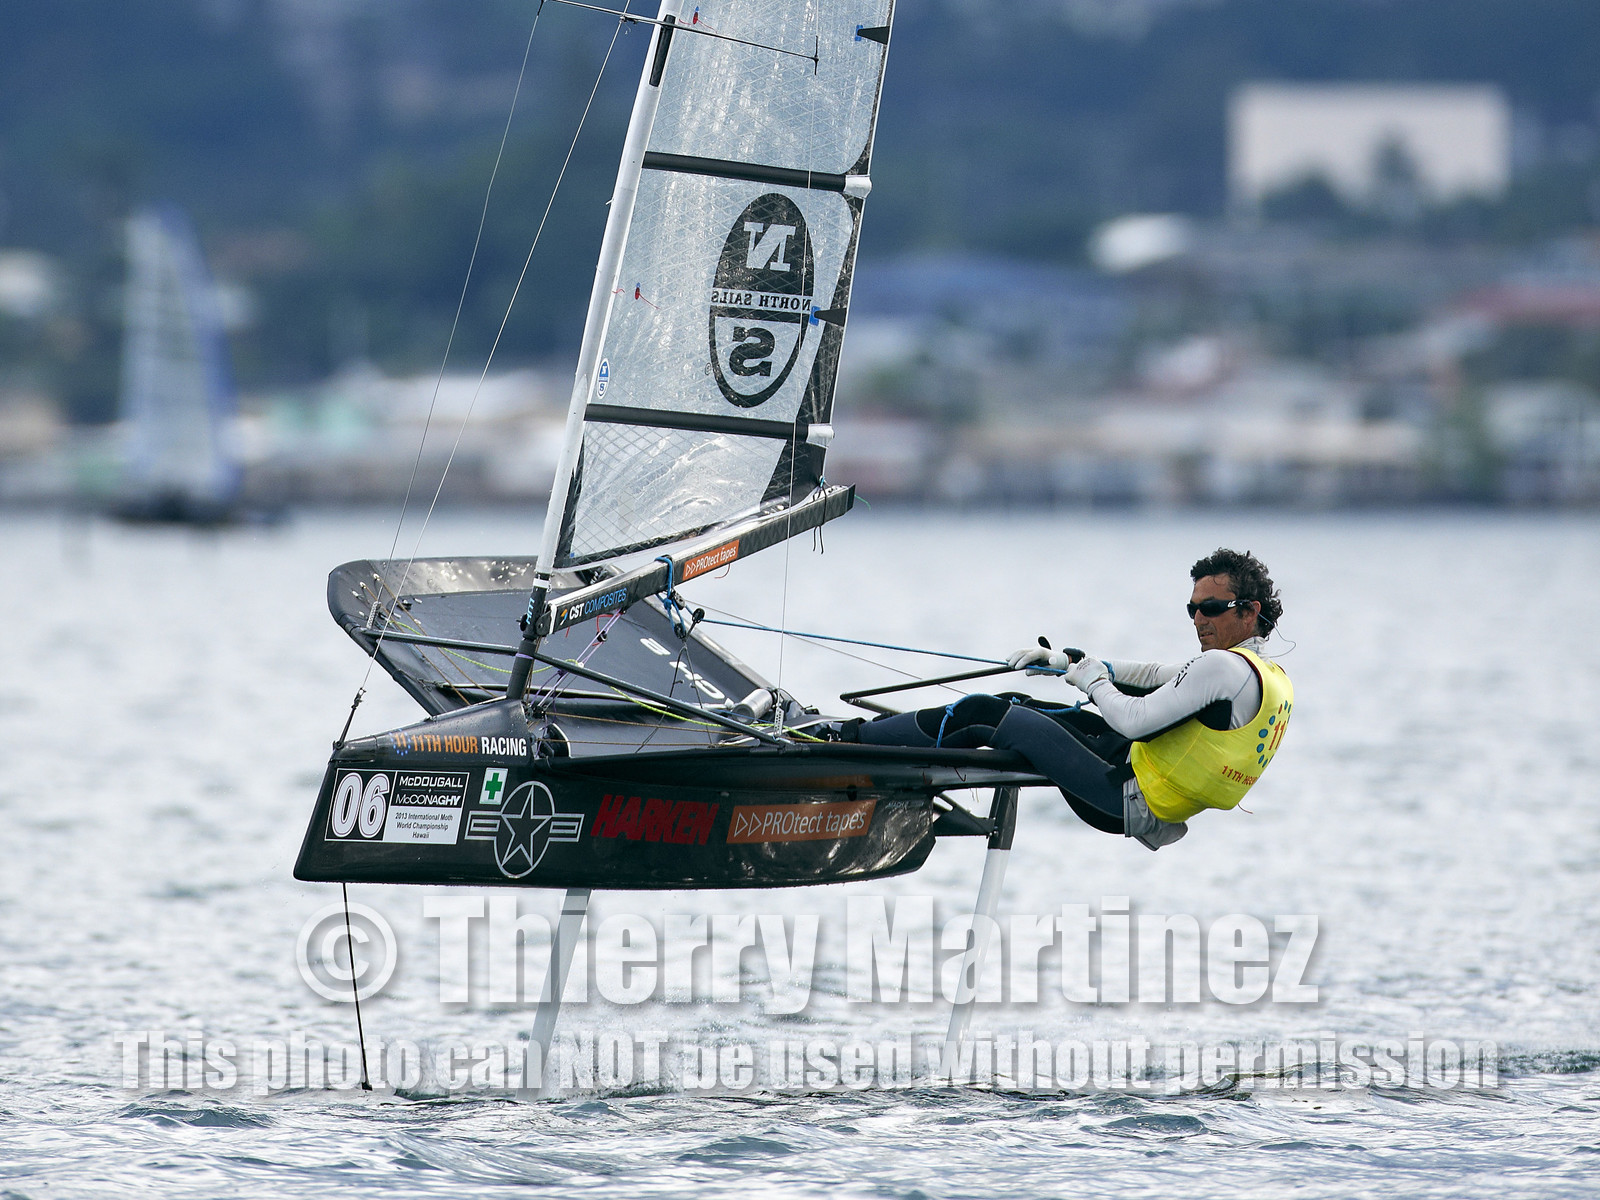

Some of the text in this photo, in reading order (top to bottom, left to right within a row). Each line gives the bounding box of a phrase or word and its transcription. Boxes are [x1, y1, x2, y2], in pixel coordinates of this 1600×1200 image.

[569, 587, 627, 620] CST COMPOSITES
[411, 734, 527, 756] 11TH HOUR RACING
[1268, 720, 1287, 751] 11
[399, 775, 463, 788] McDOUGALL
[1222, 765, 1244, 783] 11TH
[331, 772, 390, 838] 06
[395, 793, 461, 806] McCONAGHY
[395, 812, 453, 821] 2013 International Moth
[396, 821, 449, 832] World Championship
[590, 794, 720, 846] HARKEN
[761, 810, 867, 836] PROtect tapes
[412, 831, 430, 839] Hawaii
